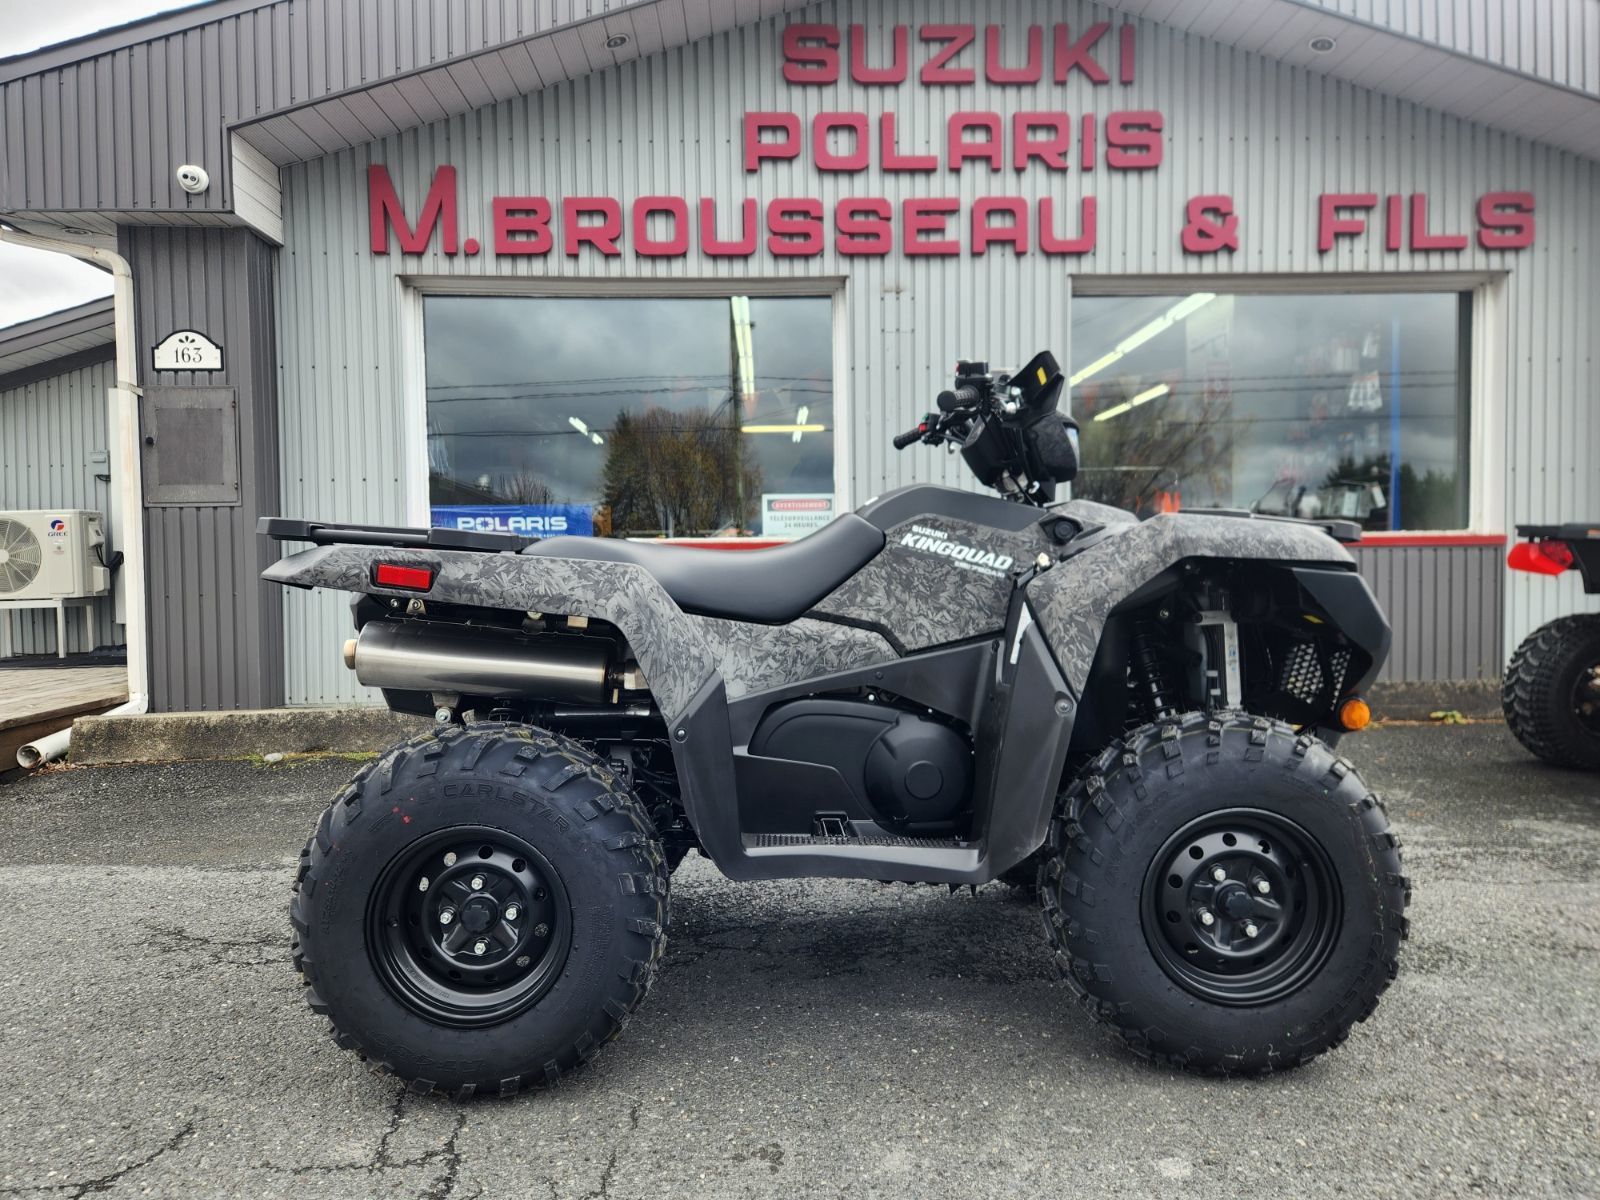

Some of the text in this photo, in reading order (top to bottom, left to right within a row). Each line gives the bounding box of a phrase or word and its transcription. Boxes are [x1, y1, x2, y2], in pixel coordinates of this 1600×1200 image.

[783, 23, 1136, 85] SUZUKI
[744, 110, 1164, 172] POLARIS
[1181, 195, 1239, 254] &
[1317, 191, 1536, 254] FILS
[174, 346, 203, 364] 163
[456, 516, 569, 532] POLARIS
[911, 524, 949, 540] SUZUKI
[900, 532, 1014, 571] KINGQUAD
[443, 783, 571, 834] CARLSTAR
